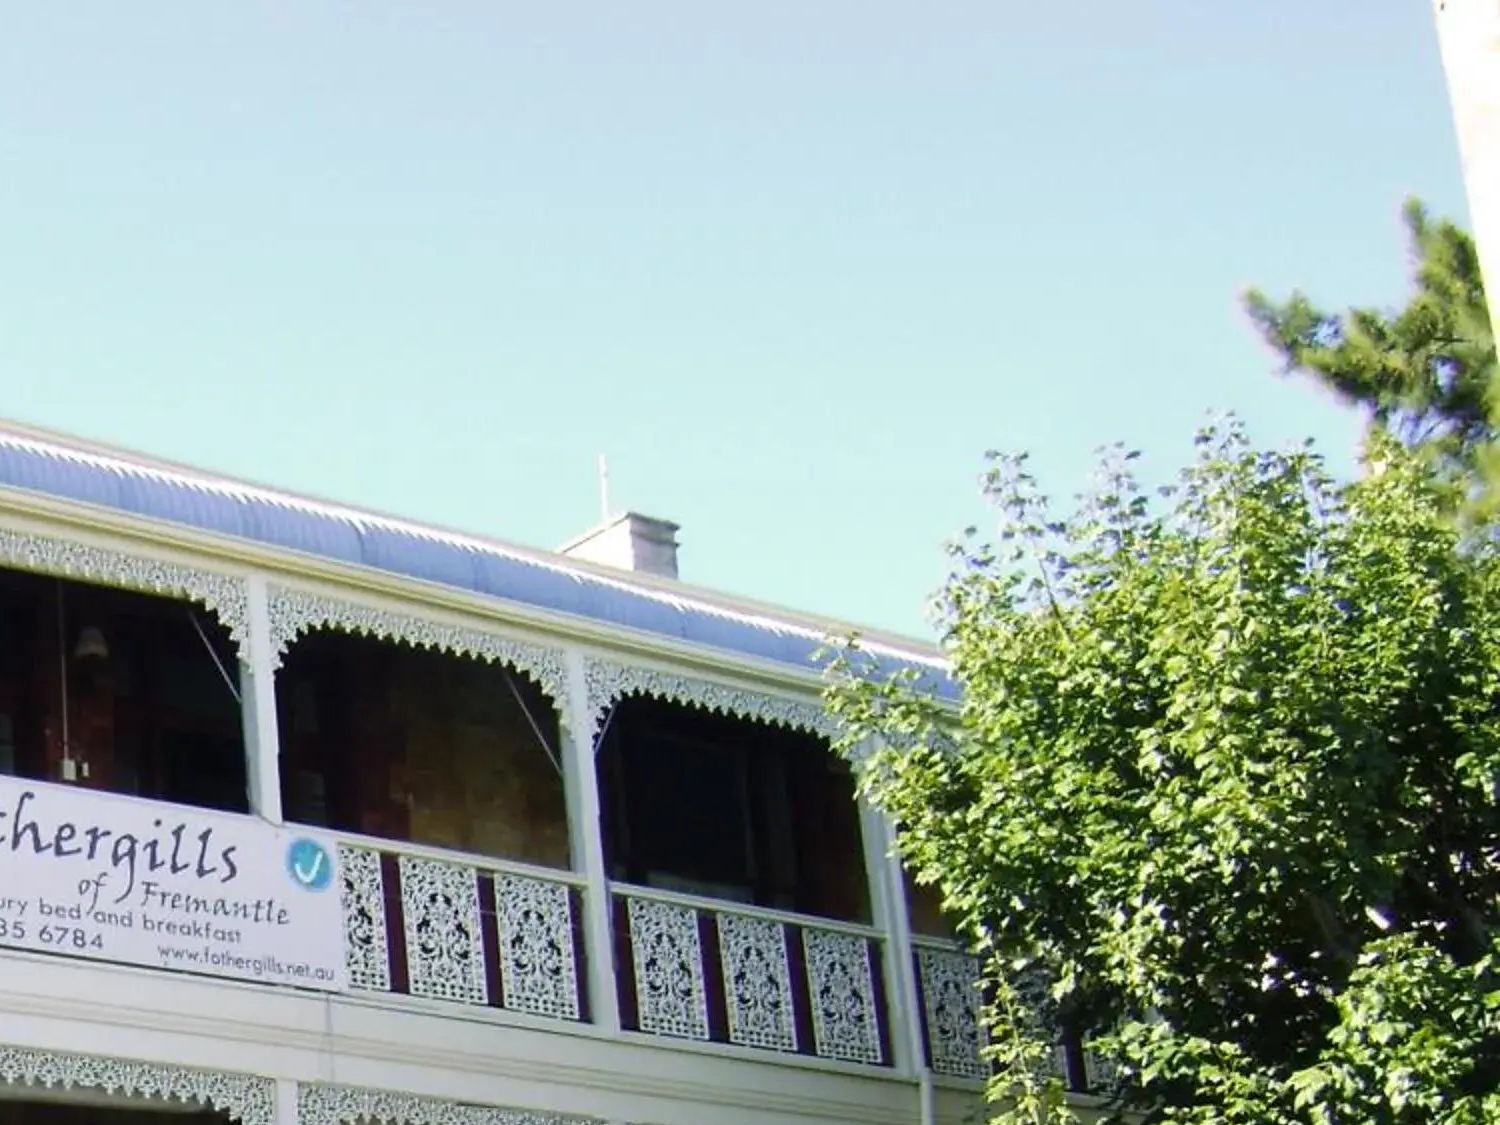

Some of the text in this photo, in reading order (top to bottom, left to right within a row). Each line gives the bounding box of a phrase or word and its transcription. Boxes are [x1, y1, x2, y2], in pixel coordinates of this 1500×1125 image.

[77, 872, 291, 926] of Fremantle
[38, 897, 82, 920] bed
[93, 911, 134, 928] and
[142, 914, 242, 944] breakfast
[38, 926, 104, 949] 6784
[157, 945, 336, 981] www.fothergills.net.au
